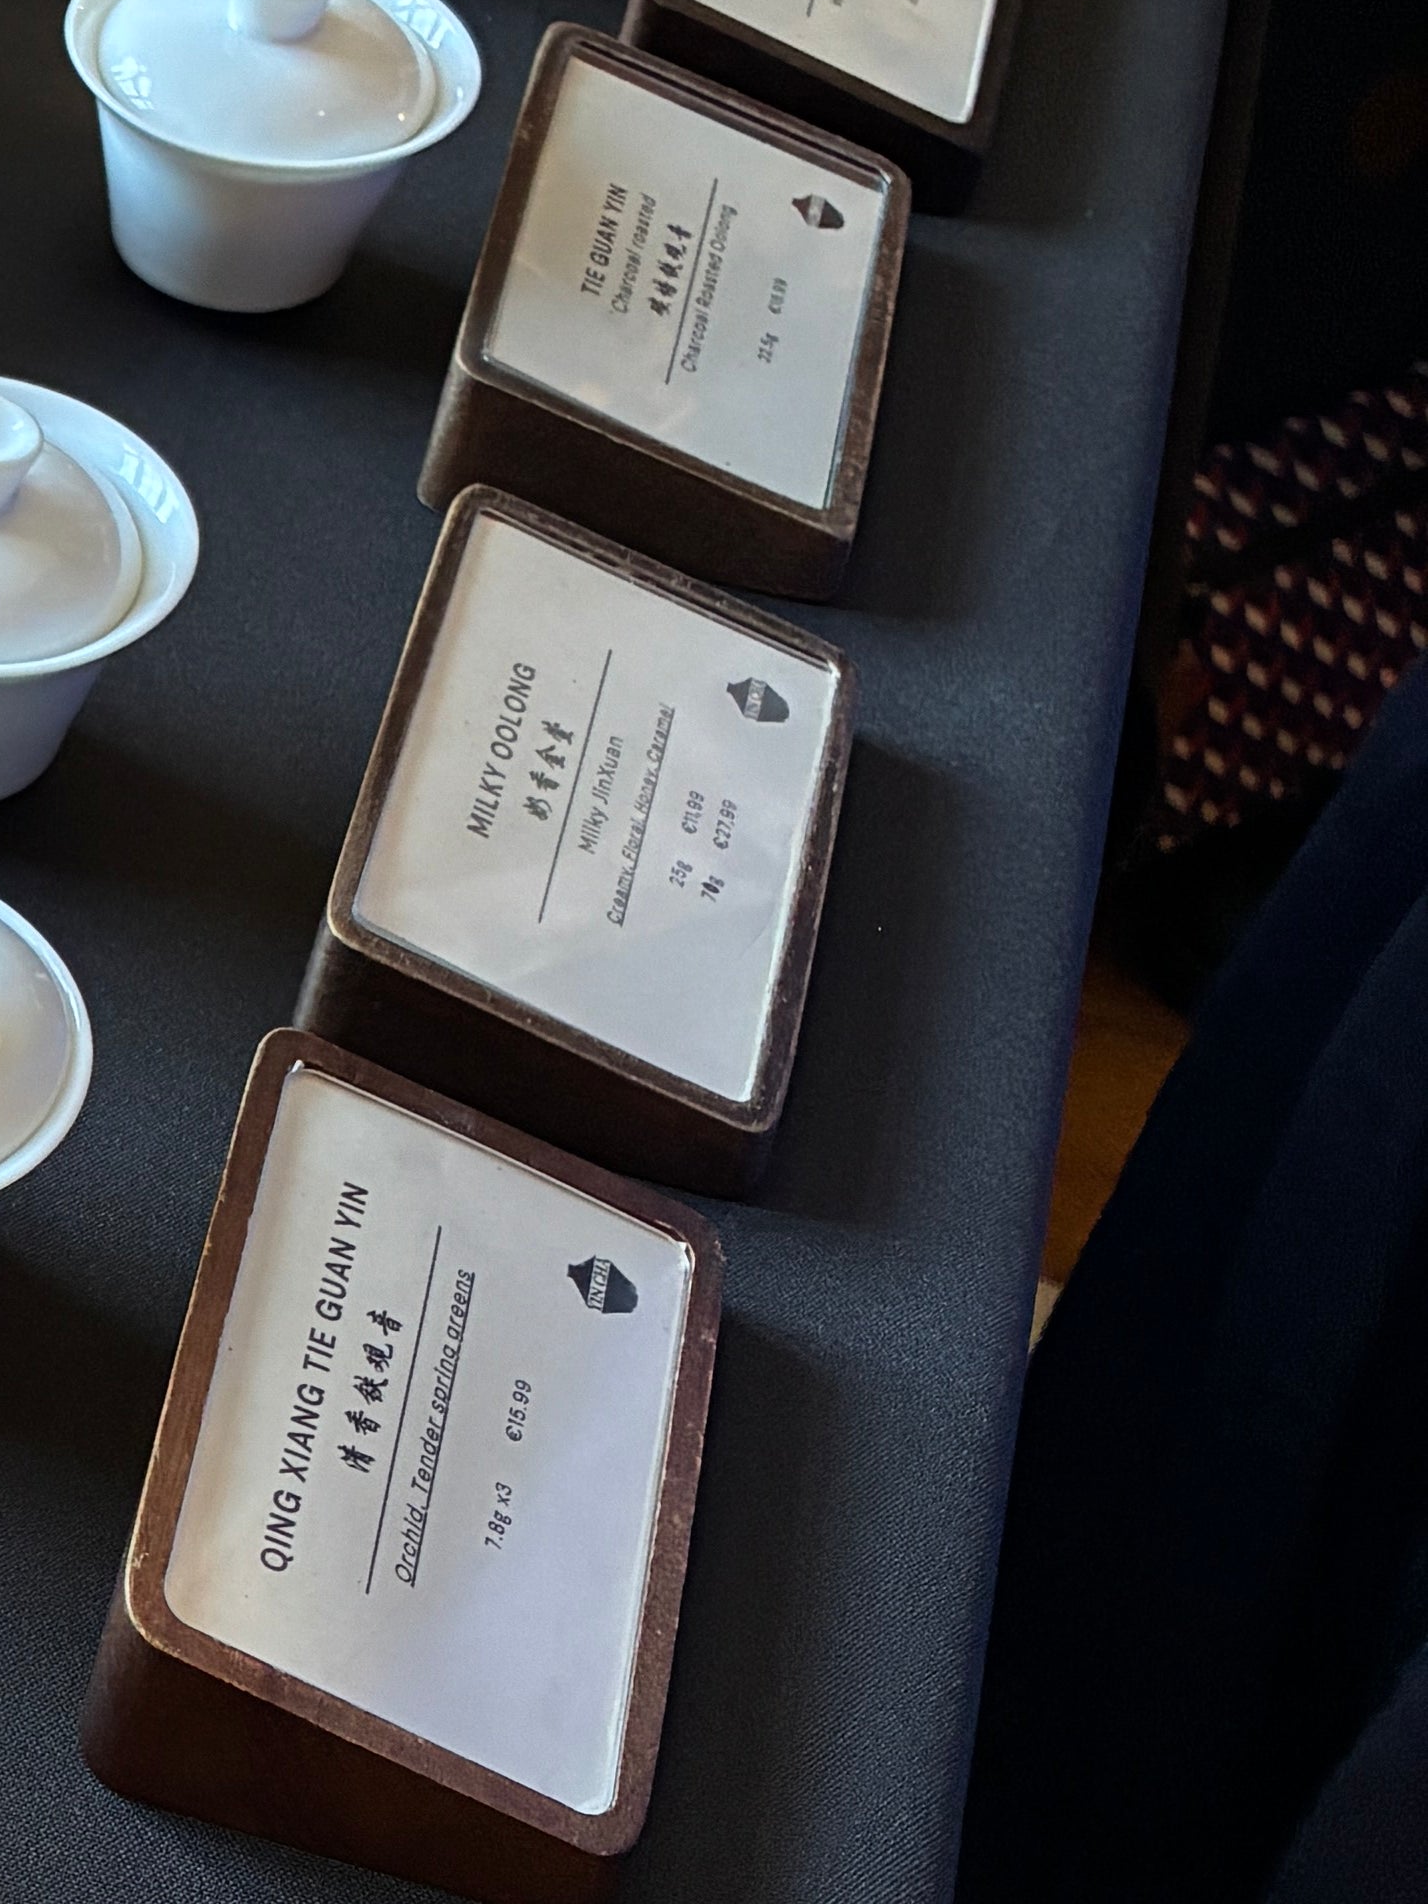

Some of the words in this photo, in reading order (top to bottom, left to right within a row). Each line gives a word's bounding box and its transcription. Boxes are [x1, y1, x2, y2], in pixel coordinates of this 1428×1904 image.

[602, 182, 628, 213] YIN
[708, 203, 738, 253] Oolong
[588, 214, 619, 267] GUAN
[610, 246, 641, 314] Charcoal
[630, 191, 656, 250] roasted
[579, 266, 606, 296] TIE
[694, 250, 723, 308] Roasted
[679, 307, 709, 373] Charcoal
[465, 760, 506, 839] MILKY
[489, 661, 536, 760] OOLONG
[645, 702, 674, 766] Caramel
[521, 719, 574, 821] 奶香金萱
[590, 735, 624, 806] JinXuan
[576, 805, 610, 855] Milky
[667, 859, 693, 888] 25g
[333, 1180, 369, 1228] YIN
[314, 1235, 356, 1322] GUAN
[301, 1326, 337, 1373] TIE
[336, 1309, 403, 1473] 清香铁观音
[409, 1414, 444, 1498] Tender
[430, 1343, 459, 1418] spring
[445, 1268, 473, 1345] greens
[504, 1378, 532, 1442] €15.99
[278, 1382, 325, 1483] XIANG
[494, 1480, 512, 1507] x3
[259, 1488, 302, 1572] QING
[483, 1508, 512, 1550] 7.8g
